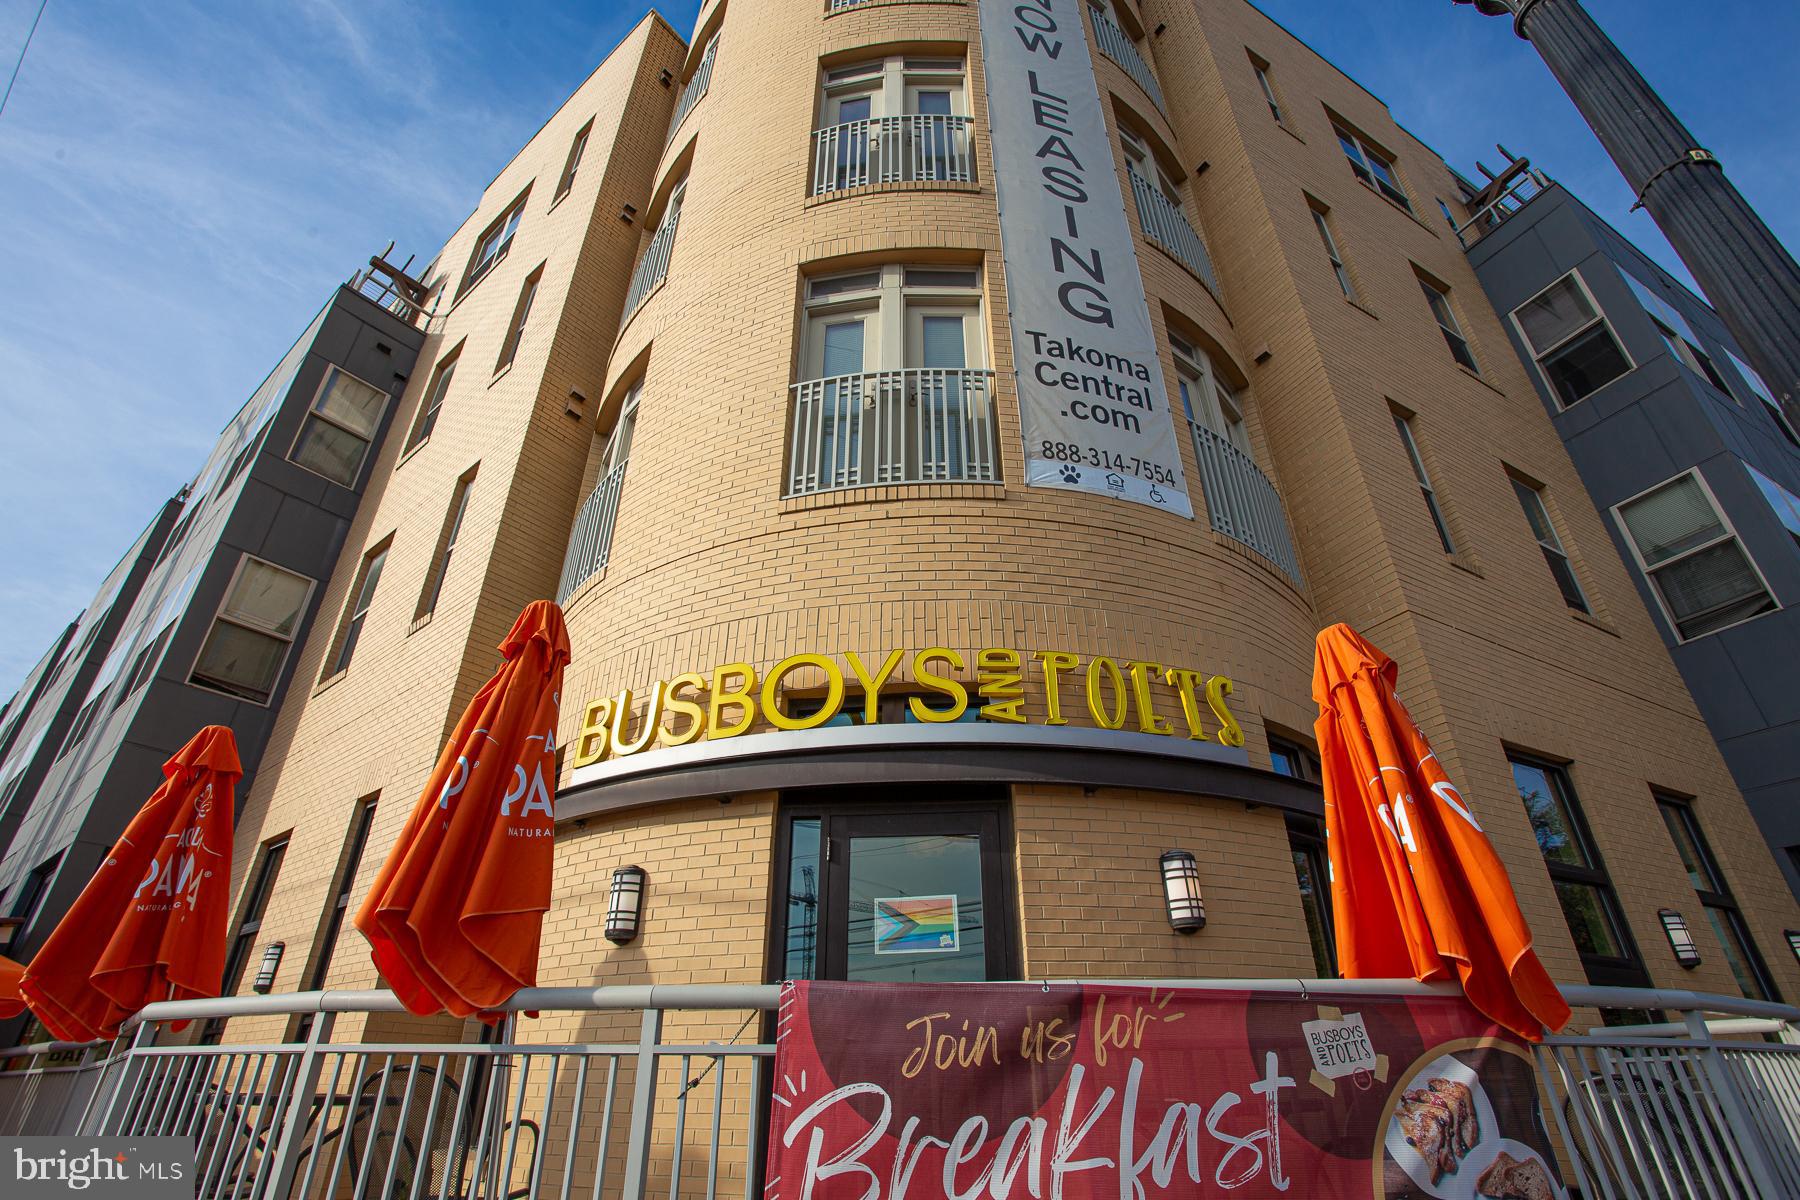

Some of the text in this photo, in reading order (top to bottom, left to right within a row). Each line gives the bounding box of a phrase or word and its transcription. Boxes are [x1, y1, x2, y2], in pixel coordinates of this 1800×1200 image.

[1014, 0, 1115, 328] OW LEASING
[1025, 330, 1151, 382] Takoma
[1034, 361, 1153, 411] Central
[1060, 400, 1141, 434] .com
[1041, 440, 1176, 487] 888-314-7554
[573, 647, 1245, 769] BUSBOYS AND POETS
[902, 994, 1157, 1079] Join us for
[1310, 1025, 1364, 1046] BUSBOYS
[1316, 1039, 1371, 1067] AND POETS
[783, 1049, 1297, 1200] Breakfast
